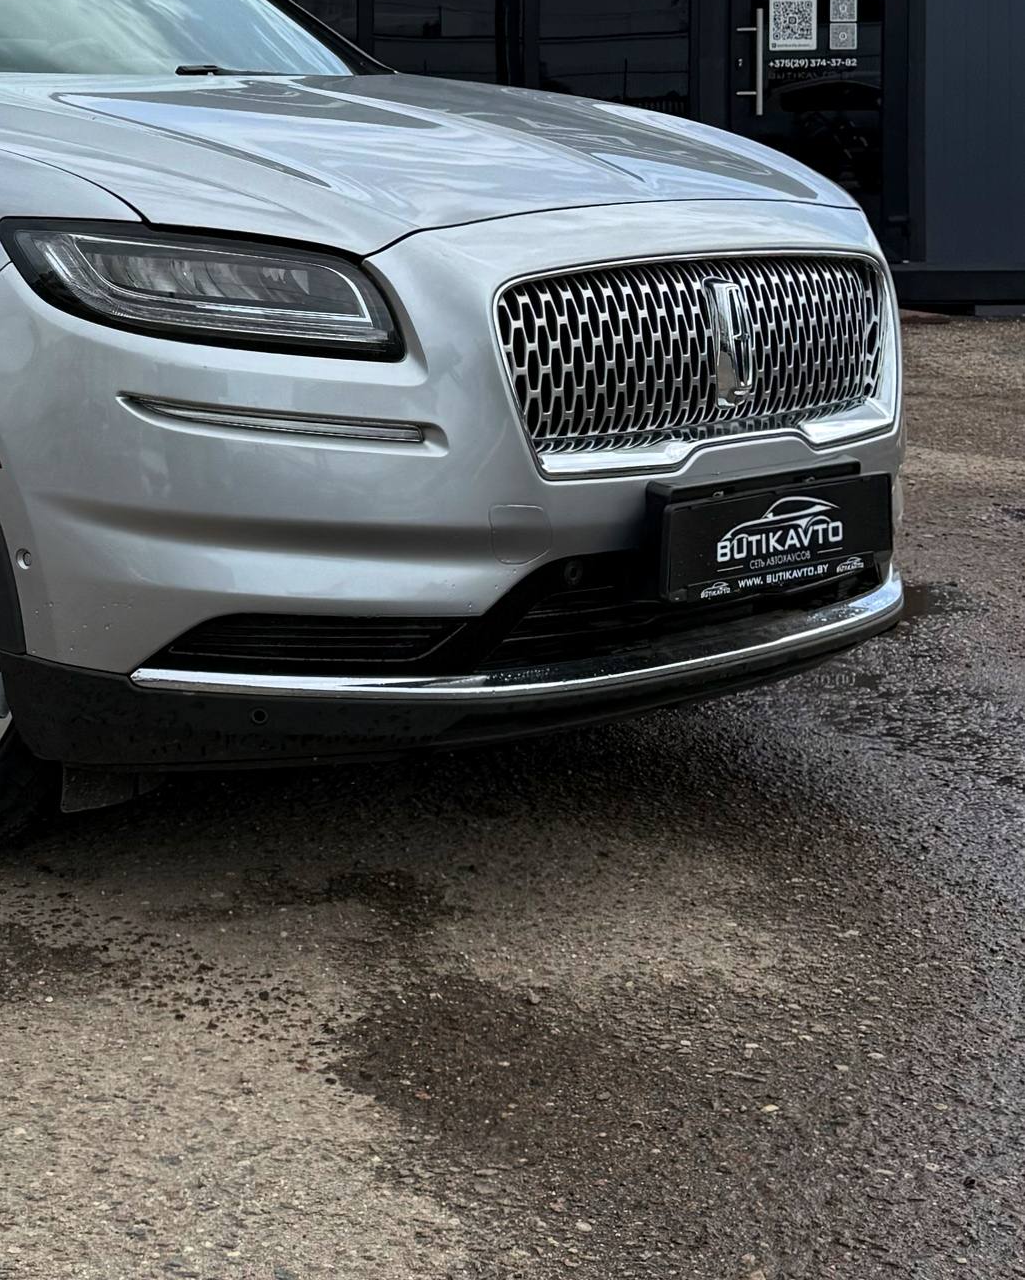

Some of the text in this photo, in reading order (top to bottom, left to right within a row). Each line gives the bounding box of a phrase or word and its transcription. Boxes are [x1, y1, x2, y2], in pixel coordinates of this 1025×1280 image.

[717, 521, 843, 563] BUTIKAVTO
[749, 550, 811, 570] СЕТЬ АВТОХАУСОВ
[766, 564, 829, 584] BUTIKAVTO.BY
